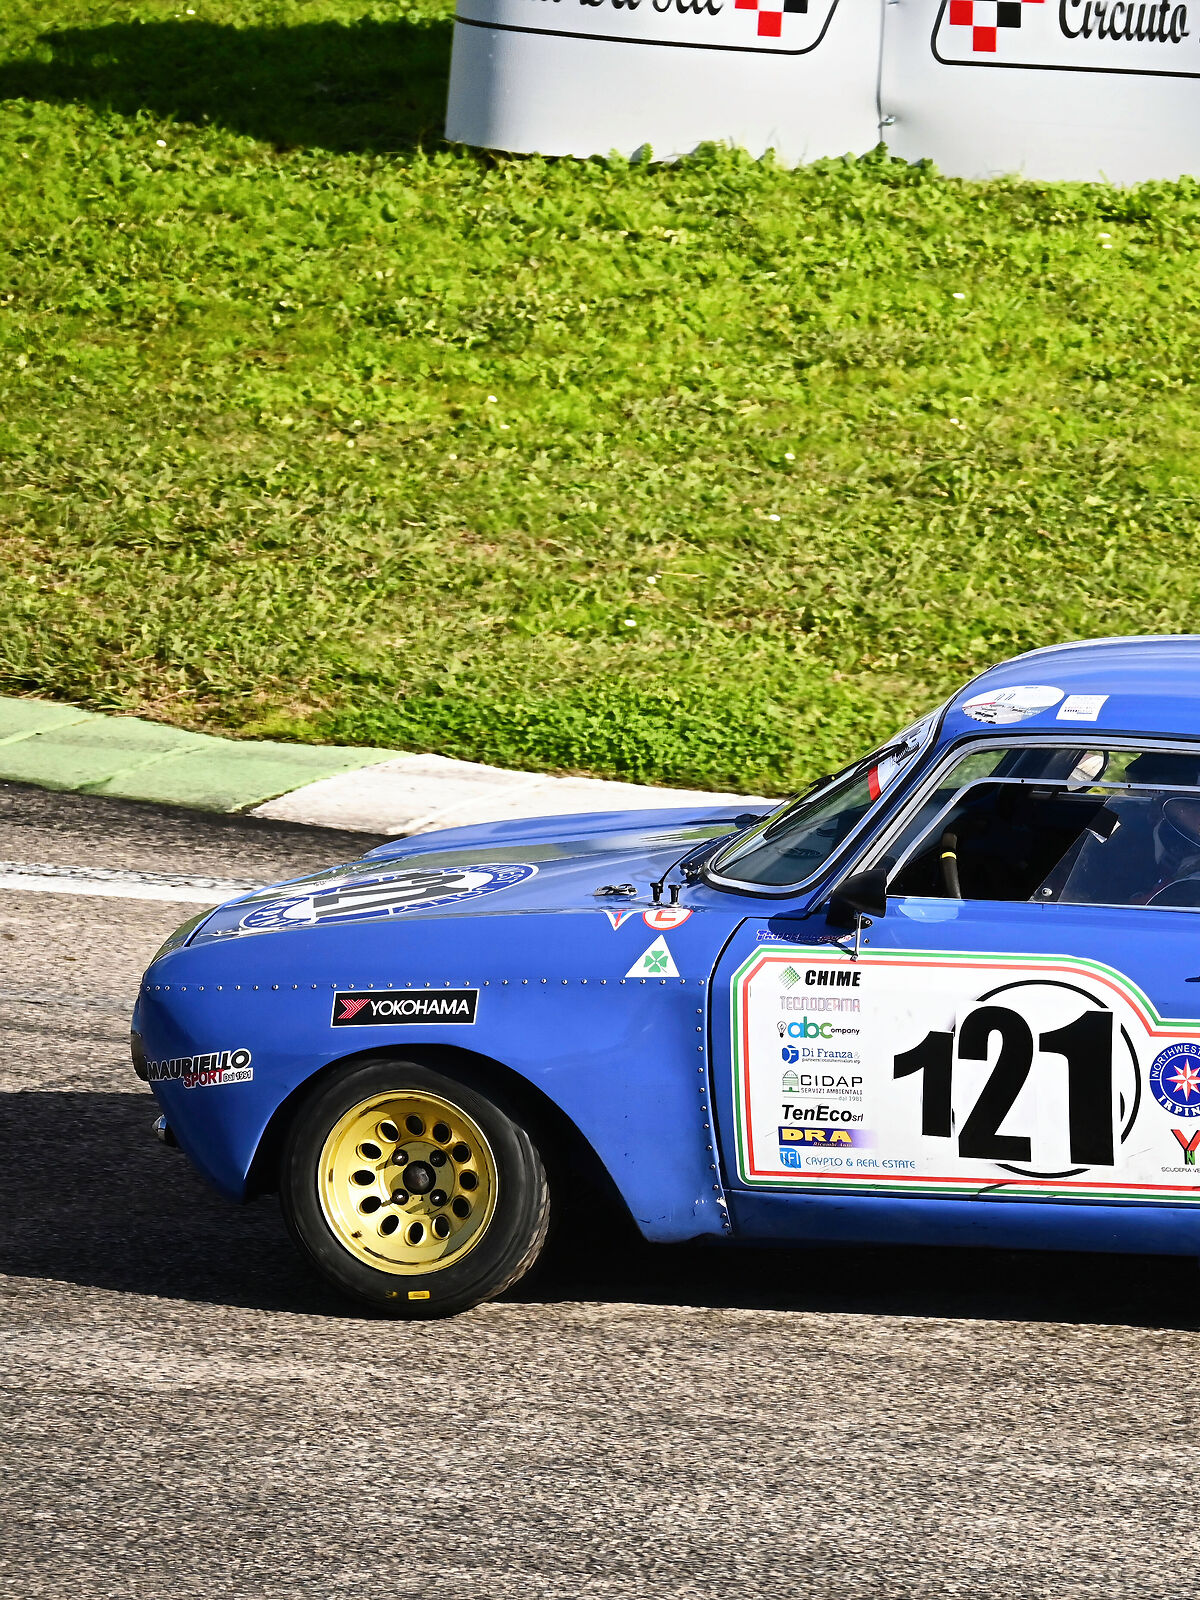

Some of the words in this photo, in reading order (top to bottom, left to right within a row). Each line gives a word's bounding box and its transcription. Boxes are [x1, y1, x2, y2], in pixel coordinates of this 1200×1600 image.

[805, 970, 862, 987] CHIME
[371, 999, 470, 1017] YOKOHAMA
[780, 996, 861, 1012] TECNODERMA
[802, 1048, 814, 1058] Di
[817, 1048, 853, 1059] Franza
[147, 1050, 251, 1080] MAURIELLO
[184, 1069, 225, 1088] SPORT
[801, 1075, 863, 1087] CIDAP
[893, 1006, 1114, 1166] 121
[781, 1128, 853, 1143] DRA
[806, 1156, 842, 1166] CRYPTO
[845, 1157, 853, 1167] &
[857, 1158, 880, 1168] REAL
[882, 1159, 916, 1169] ESTATE
